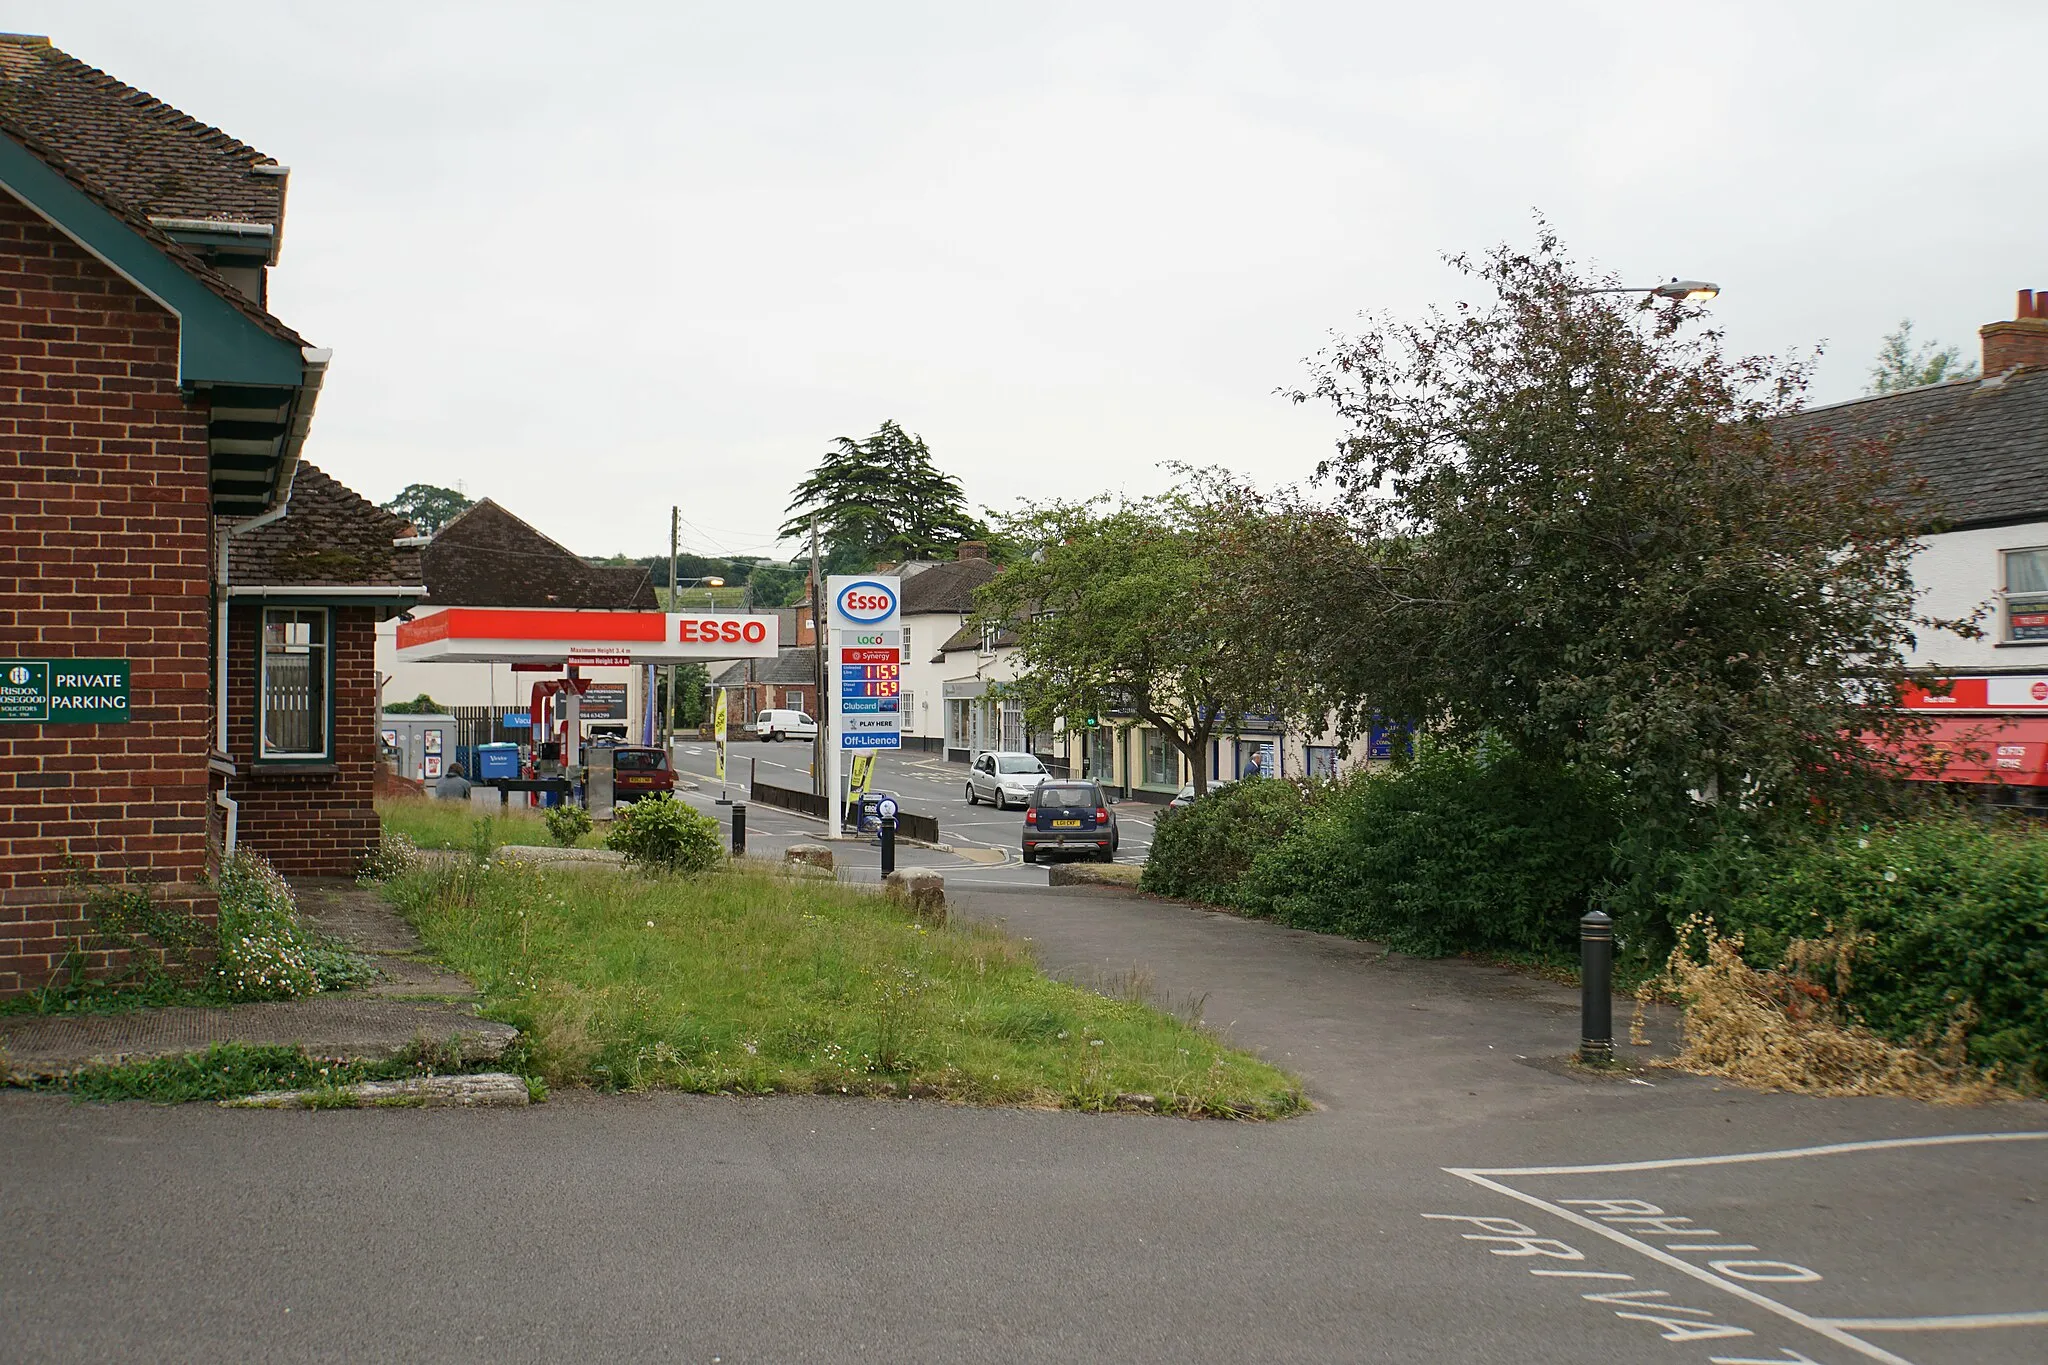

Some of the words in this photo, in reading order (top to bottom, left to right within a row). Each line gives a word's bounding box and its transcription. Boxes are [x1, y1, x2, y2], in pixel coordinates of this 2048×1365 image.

[847, 592, 889, 610] Esso
[679, 620, 766, 643] ESSO
[597, 647, 615, 655] Height
[596, 657, 613, 665] Height
[862, 653, 890, 661] Synergy
[57, 675, 121, 687] PRIVATE
[0, 686, 39, 695] RISDON
[0, 695, 46, 704] OSEGOOD
[51, 695, 126, 709] PARKING
[843, 702, 877, 710] Clubcard
[844, 736, 898, 745] Off-Licence
